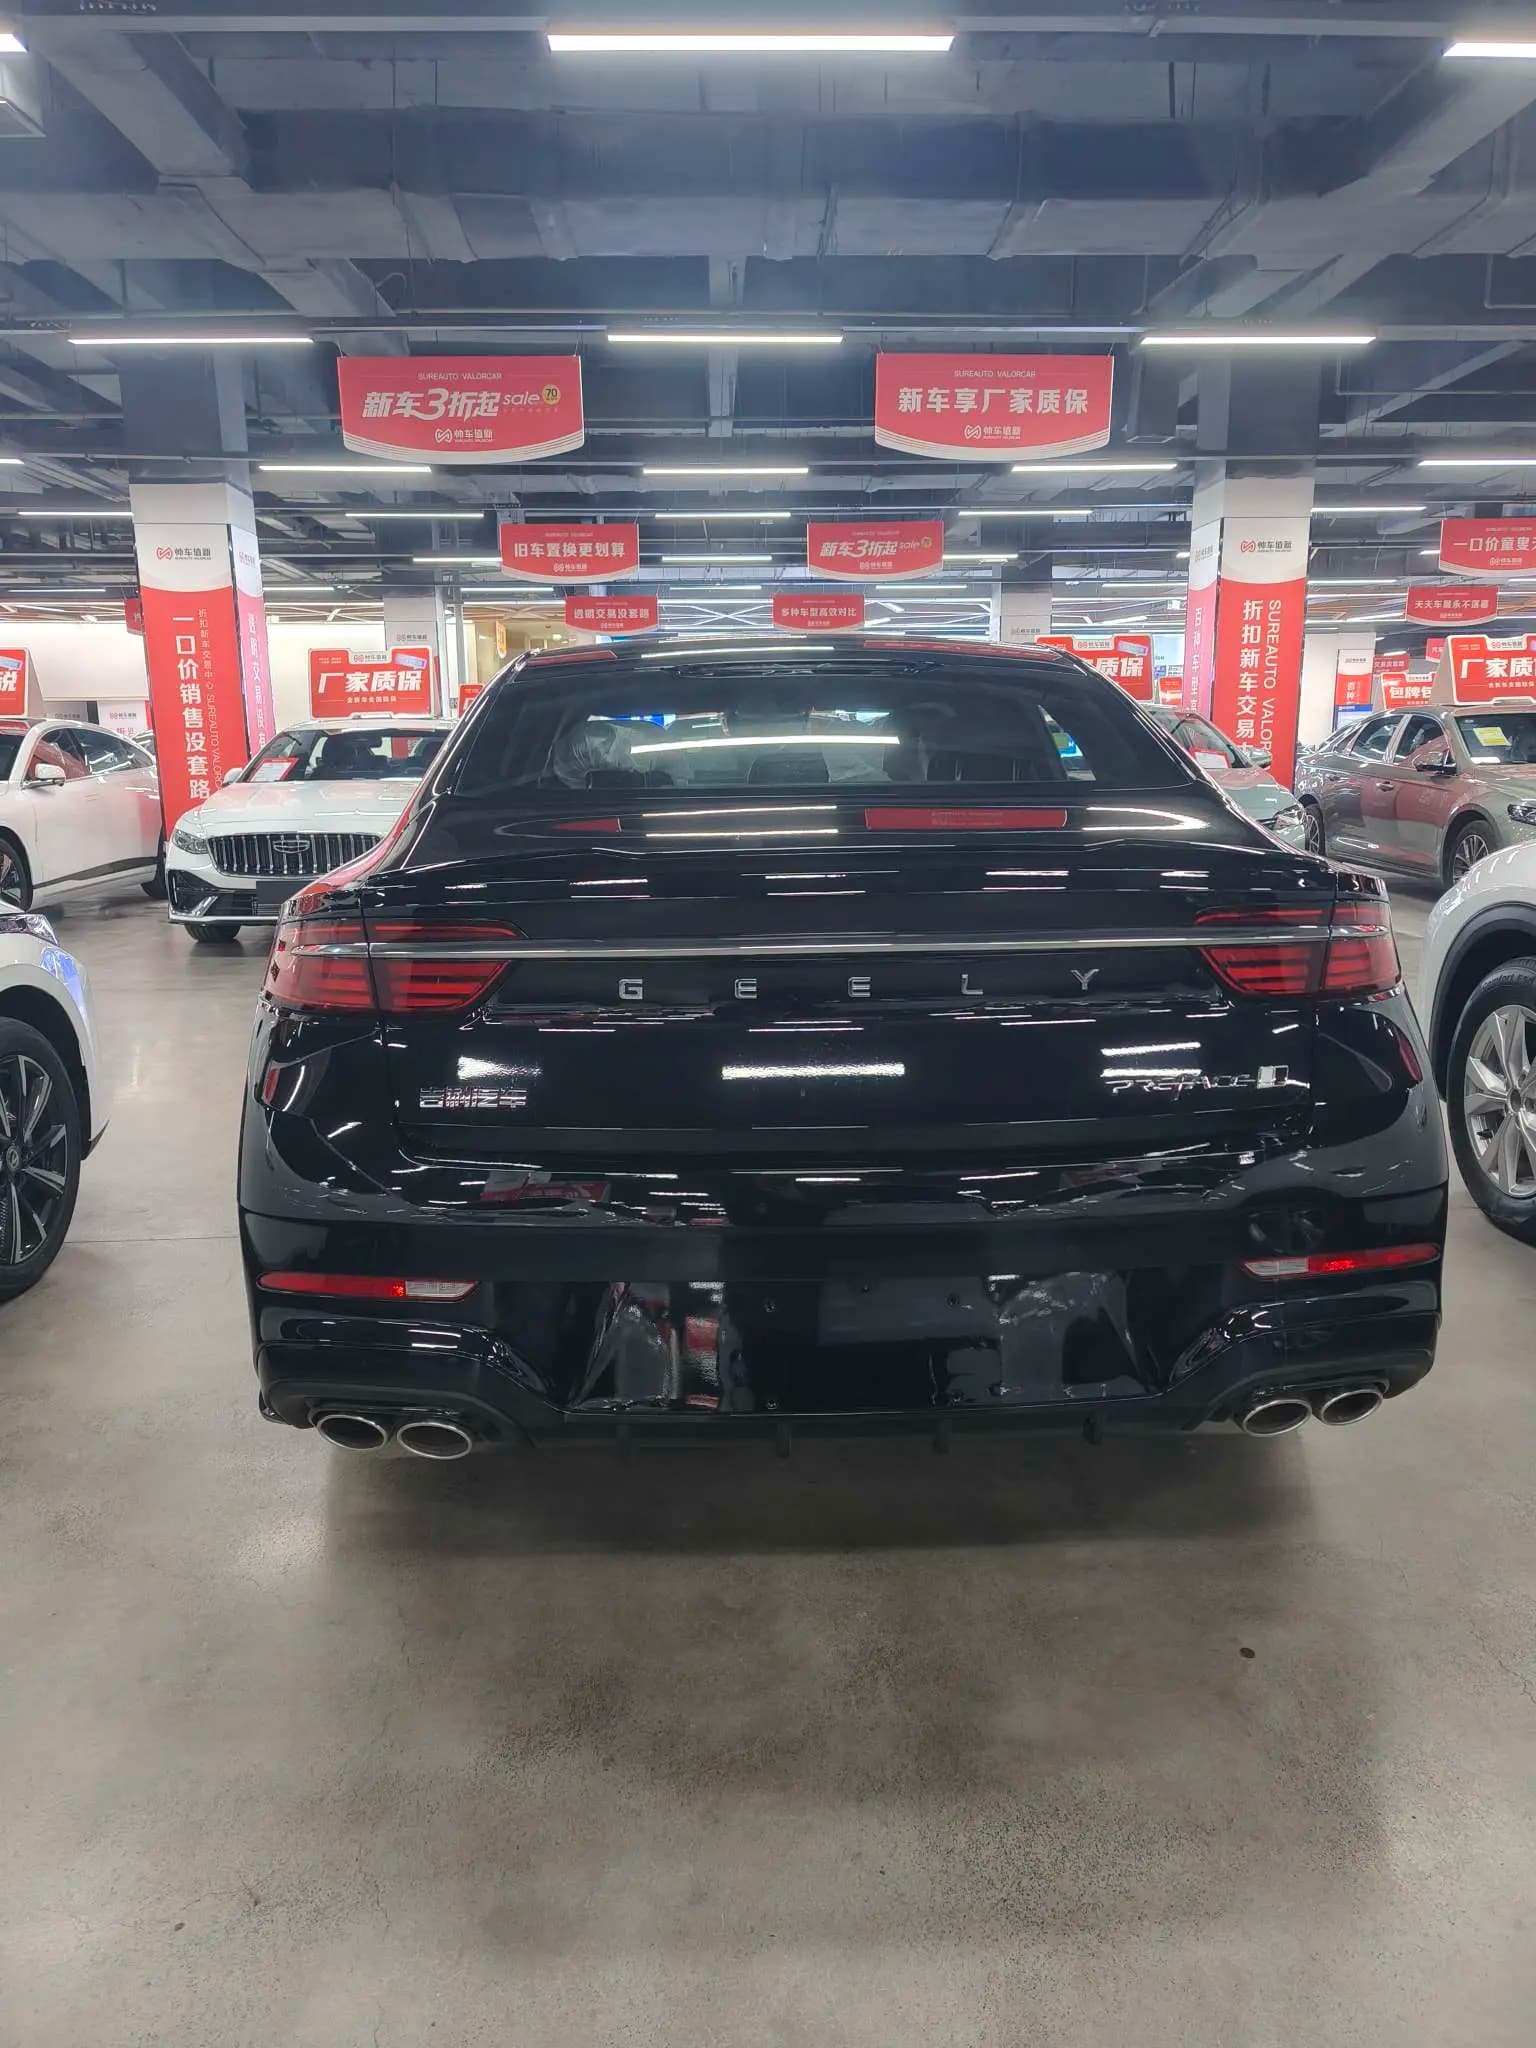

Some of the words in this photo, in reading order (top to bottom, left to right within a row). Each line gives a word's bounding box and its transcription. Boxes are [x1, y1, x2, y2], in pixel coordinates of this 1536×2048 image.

[362, 388, 500, 422] 新车3折起
[502, 391, 540, 406] sale
[898, 387, 1088, 415] 新车享厂家质保
[514, 542, 625, 558] 旧车置换更划算
[820, 540, 898, 558] 新车3折起
[1263, 600, 1282, 689] SUREAUTO
[1461, 657, 1536, 679] 厂家质
[318, 671, 423, 694] 厂家质保
[172, 616, 211, 800] 一口价销售没套路
[618, 968, 1099, 1000] GEELY
[1104, 1074, 1256, 1101] PREFACE
